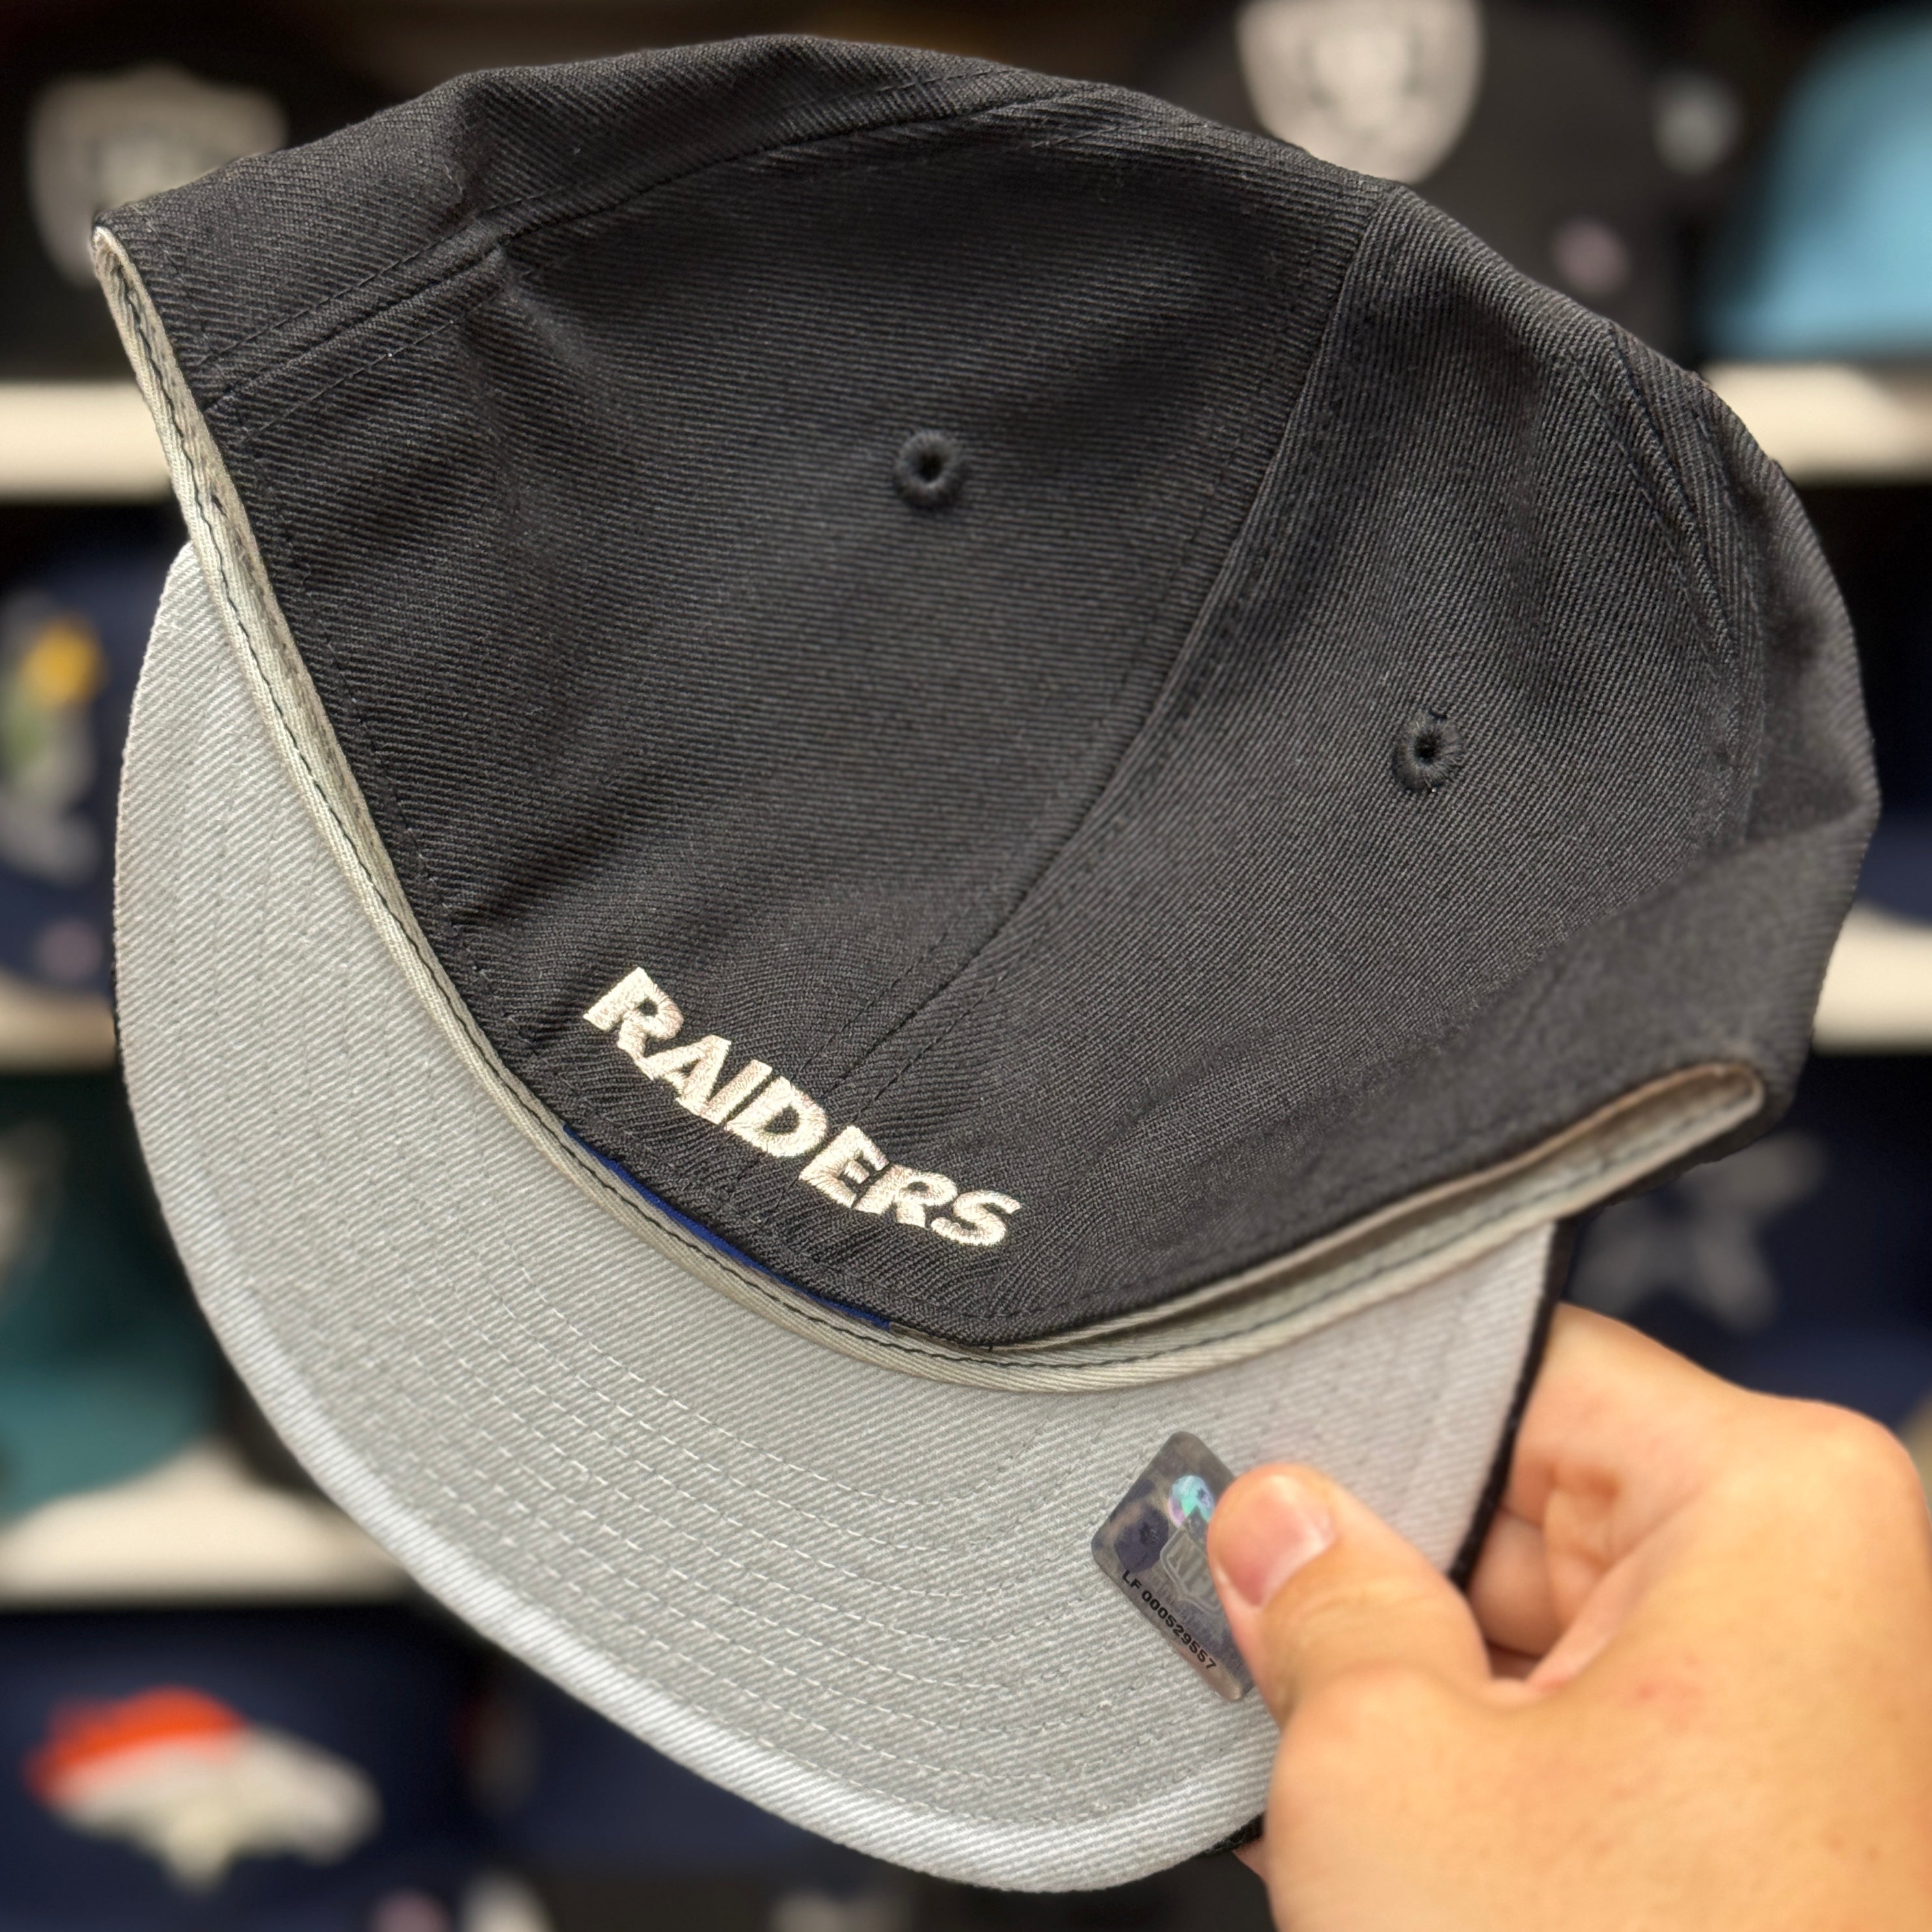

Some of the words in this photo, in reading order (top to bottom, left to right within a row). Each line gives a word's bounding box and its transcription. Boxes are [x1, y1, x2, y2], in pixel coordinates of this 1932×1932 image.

[583, 967, 1022, 1246] RAIDERS
[1122, 1570, 1141, 1590] LF
[1142, 1590, 1217, 1670] 000529557
